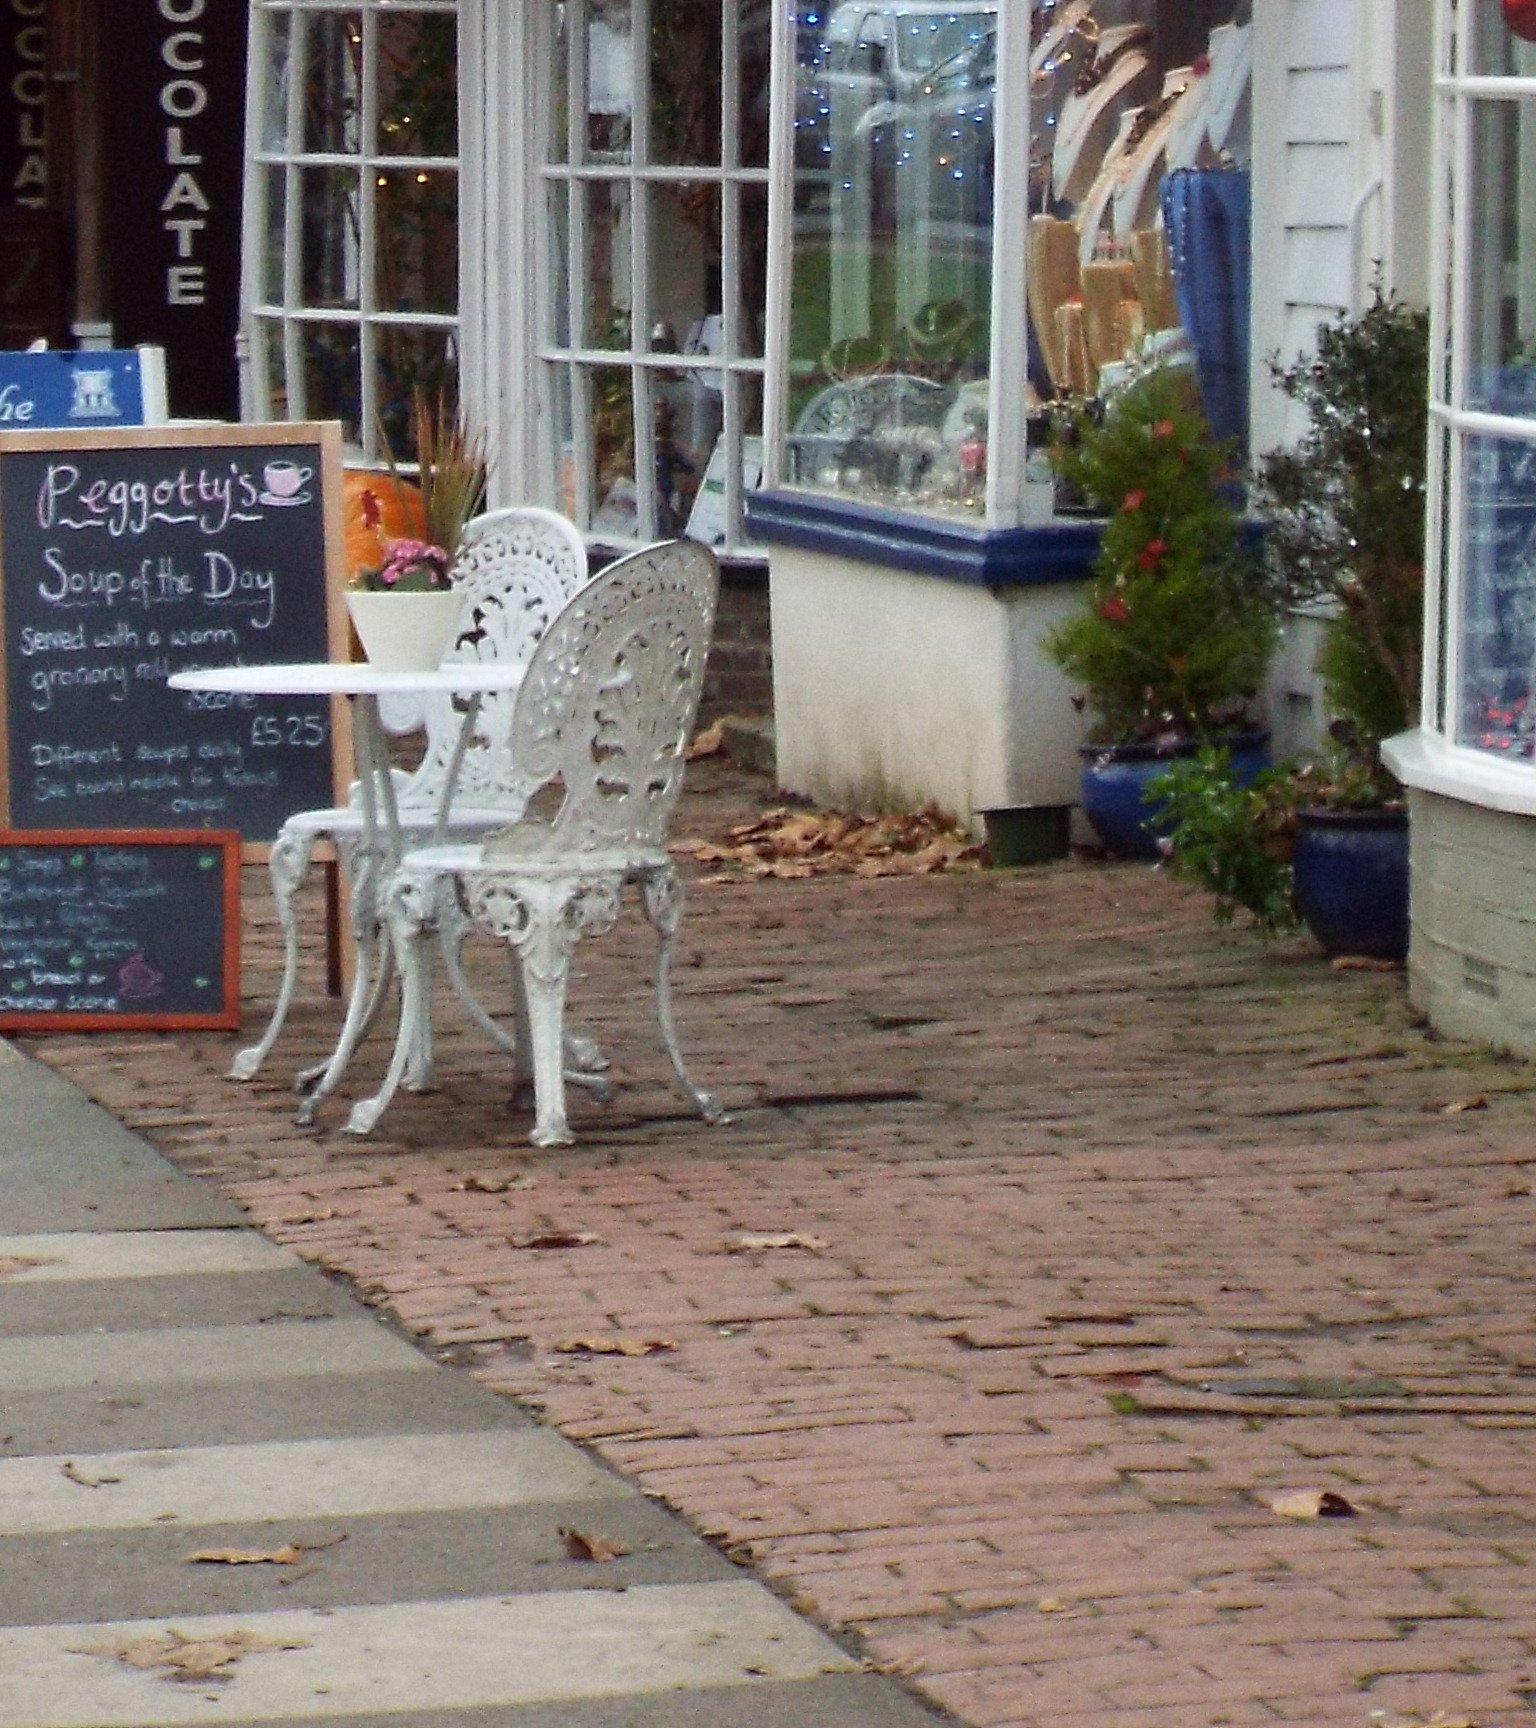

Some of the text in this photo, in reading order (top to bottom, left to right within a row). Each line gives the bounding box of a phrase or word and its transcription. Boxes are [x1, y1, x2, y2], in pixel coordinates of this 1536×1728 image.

[36, 463, 257, 537] Peggotty's
[39, 547, 275, 629] Soup of the Day
[94, 621, 139, 648] with
[170, 626, 237, 646] warm
